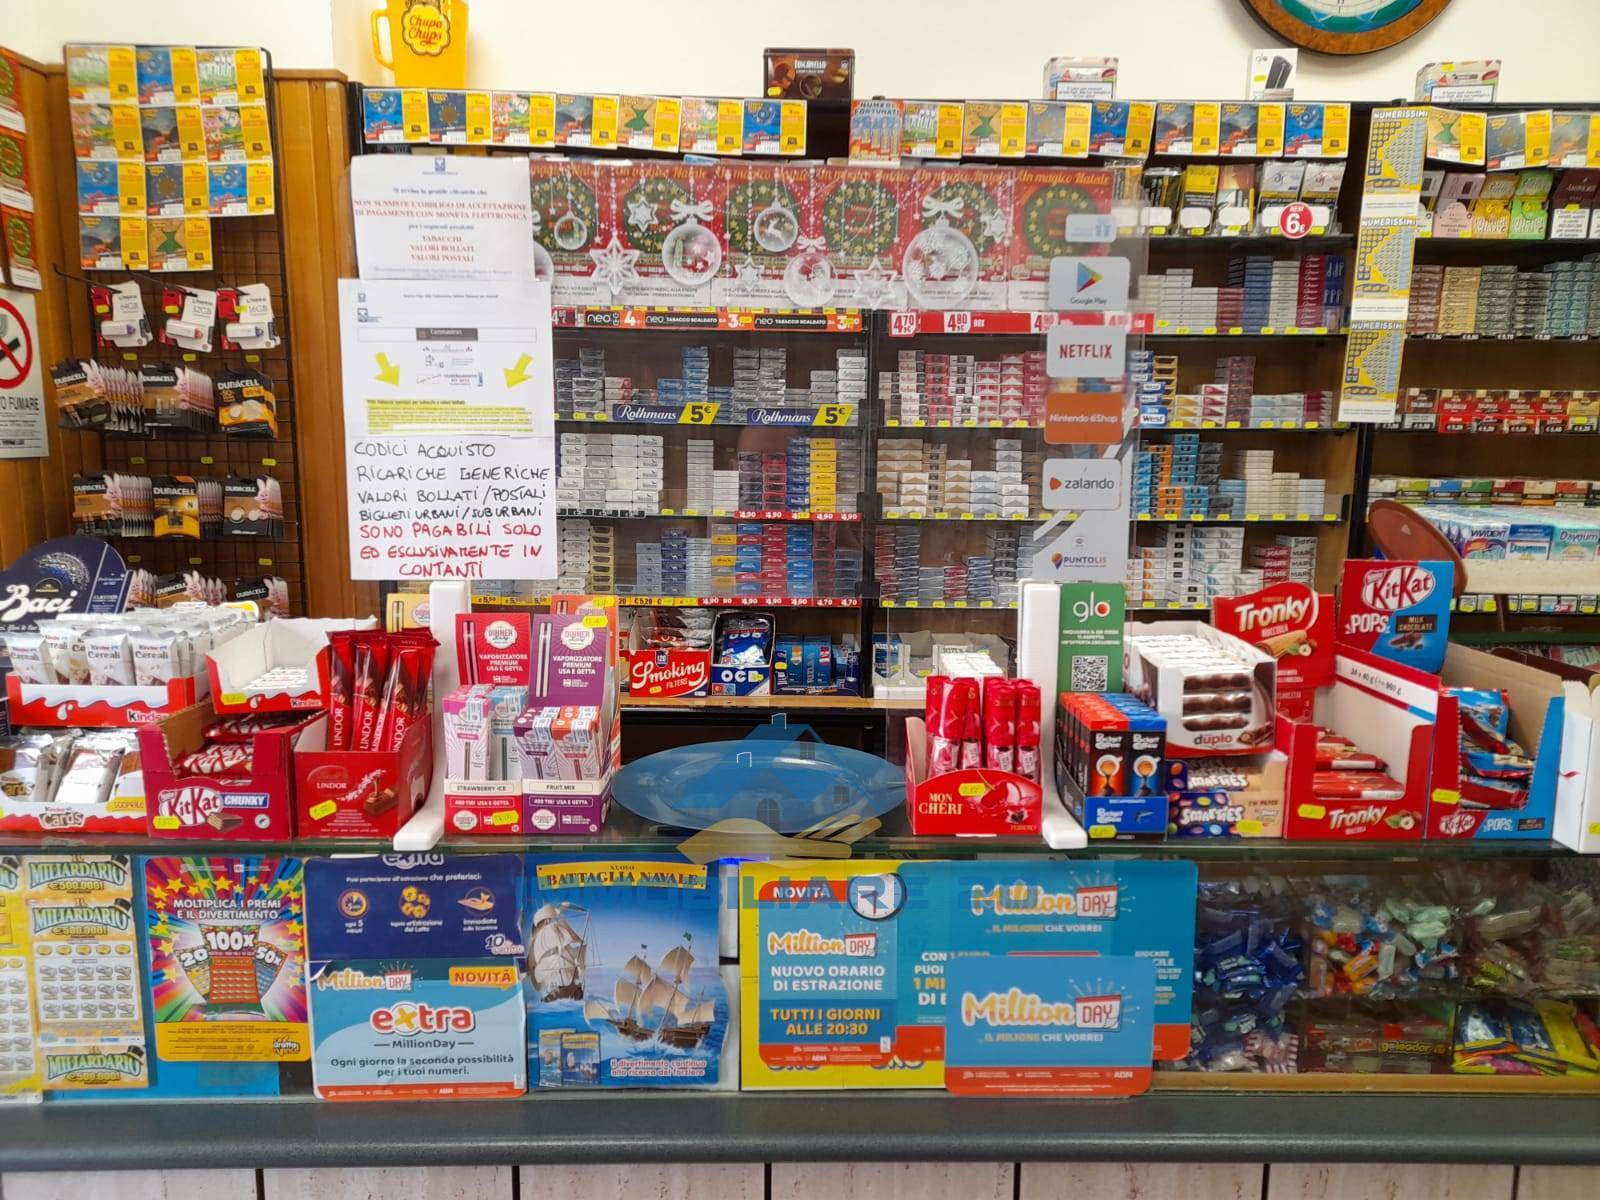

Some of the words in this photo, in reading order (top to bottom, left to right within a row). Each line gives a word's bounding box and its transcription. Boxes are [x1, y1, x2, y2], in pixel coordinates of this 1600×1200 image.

[409, 14, 443, 30] Chupa
[408, 27, 443, 45] Chups
[1070, 297, 1092, 305] Google
[1094, 297, 1107, 305] Play
[1059, 344, 1112, 359] NETFLIX
[54, 373, 86, 384] DURACELL
[217, 379, 260, 390] DURACELL
[9, 397, 39, 411] FUMARE
[617, 405, 677, 420] Rothmans
[751, 409, 812, 424] Rothmans
[1050, 412, 1088, 423] Nintendo
[1090, 412, 1118, 424] eShop
[354, 440, 408, 456] CODICI
[418, 441, 496, 459] ACQUISTO
[356, 464, 448, 481] RICARICHE
[460, 464, 550, 481] GENERICHE
[153, 487, 196, 495] DURACELL
[1064, 478, 1115, 490] zalando
[358, 488, 408, 504] VALORI
[359, 524, 404, 539] SONO
[412, 520, 491, 537] PAGABILI
[502, 523, 542, 536] SOLO
[360, 546, 380, 559] ED
[387, 543, 514, 559] ESCLUSIVAMENTE
[523, 545, 543, 557] IN
[399, 560, 485, 578] CONTANTI
[1371, 568, 1431, 609] KitKat
[0, 584, 78, 622] Baci
[1073, 592, 1110, 623] glo
[1234, 595, 1310, 632] Tronky
[1350, 614, 1390, 633] POPS
[632, 660, 705, 689] Smoking
[666, 678, 687, 688] FILTERS
[332, 706, 344, 746] LINDOR
[359, 709, 374, 750] LINDOR
[1194, 733, 1232, 746] duplo
[225, 795, 265, 806] CHUNKY
[929, 793, 952, 802] MON
[168, 787, 220, 826] KitKat
[43, 812, 81, 825] Cards
[1329, 806, 1388, 830] Tronky
[29, 862, 126, 889] MILIARDARIO
[430, 873, 444, 881] che
[546, 871, 635, 886] BATTAGLIA
[640, 873, 699, 886] NAVALE
[773, 883, 831, 899] NOVITÀ
[173, 899, 237, 910] MOLTIPLICA
[247, 899, 281, 909] PREMI
[971, 882, 1076, 916] Million
[1082, 895, 1111, 913] DAY
[33, 907, 129, 934] MILIARDARIO
[177, 911, 184, 919] E
[186, 911, 196, 919] IL
[1045, 924, 1063, 933] CHE
[207, 932, 256, 951] 100x
[768, 929, 845, 955] Million
[850, 940, 871, 954] DAY
[256, 946, 283, 966] 50x
[922, 953, 947, 962] CON
[455, 969, 511, 984] NOVITÀ
[771, 966, 825, 976] NUOVO
[828, 965, 885, 976] ORARIO
[915, 965, 944, 974] PUOI
[318, 969, 386, 991] Million
[389, 976, 407, 988] DAY
[773, 981, 788, 991] DI
[791, 980, 883, 991] ESTRAZIONE
[770, 1009, 816, 1020] TUTTI
[826, 1009, 881, 1020] GIORNI
[962, 988, 1075, 1026] Million
[1082, 1006, 1112, 1023] DAY
[371, 1005, 473, 1031] extra
[786, 1024, 822, 1035] ALLE
[826, 1024, 868, 1035] 20:30
[393, 1038, 456, 1049] MillionDay
[1042, 1033, 1062, 1042] CHE
[1064, 1033, 1104, 1042] VORREI
[47, 1054, 142, 1081] MILIARDARIO
[330, 1058, 356, 1068] Ogni
[359, 1057, 394, 1068] giorno
[397, 1056, 407, 1066] la
[409, 1056, 455, 1066] seconda
[457, 1054, 514, 1067] possibilità
[619, 1059, 669, 1067] divertimento
[671, 1059, 707, 1068] continua
[377, 1068, 394, 1078] per
[403, 1066, 426, 1076] tuoi
[428, 1065, 469, 1076] numeri.
